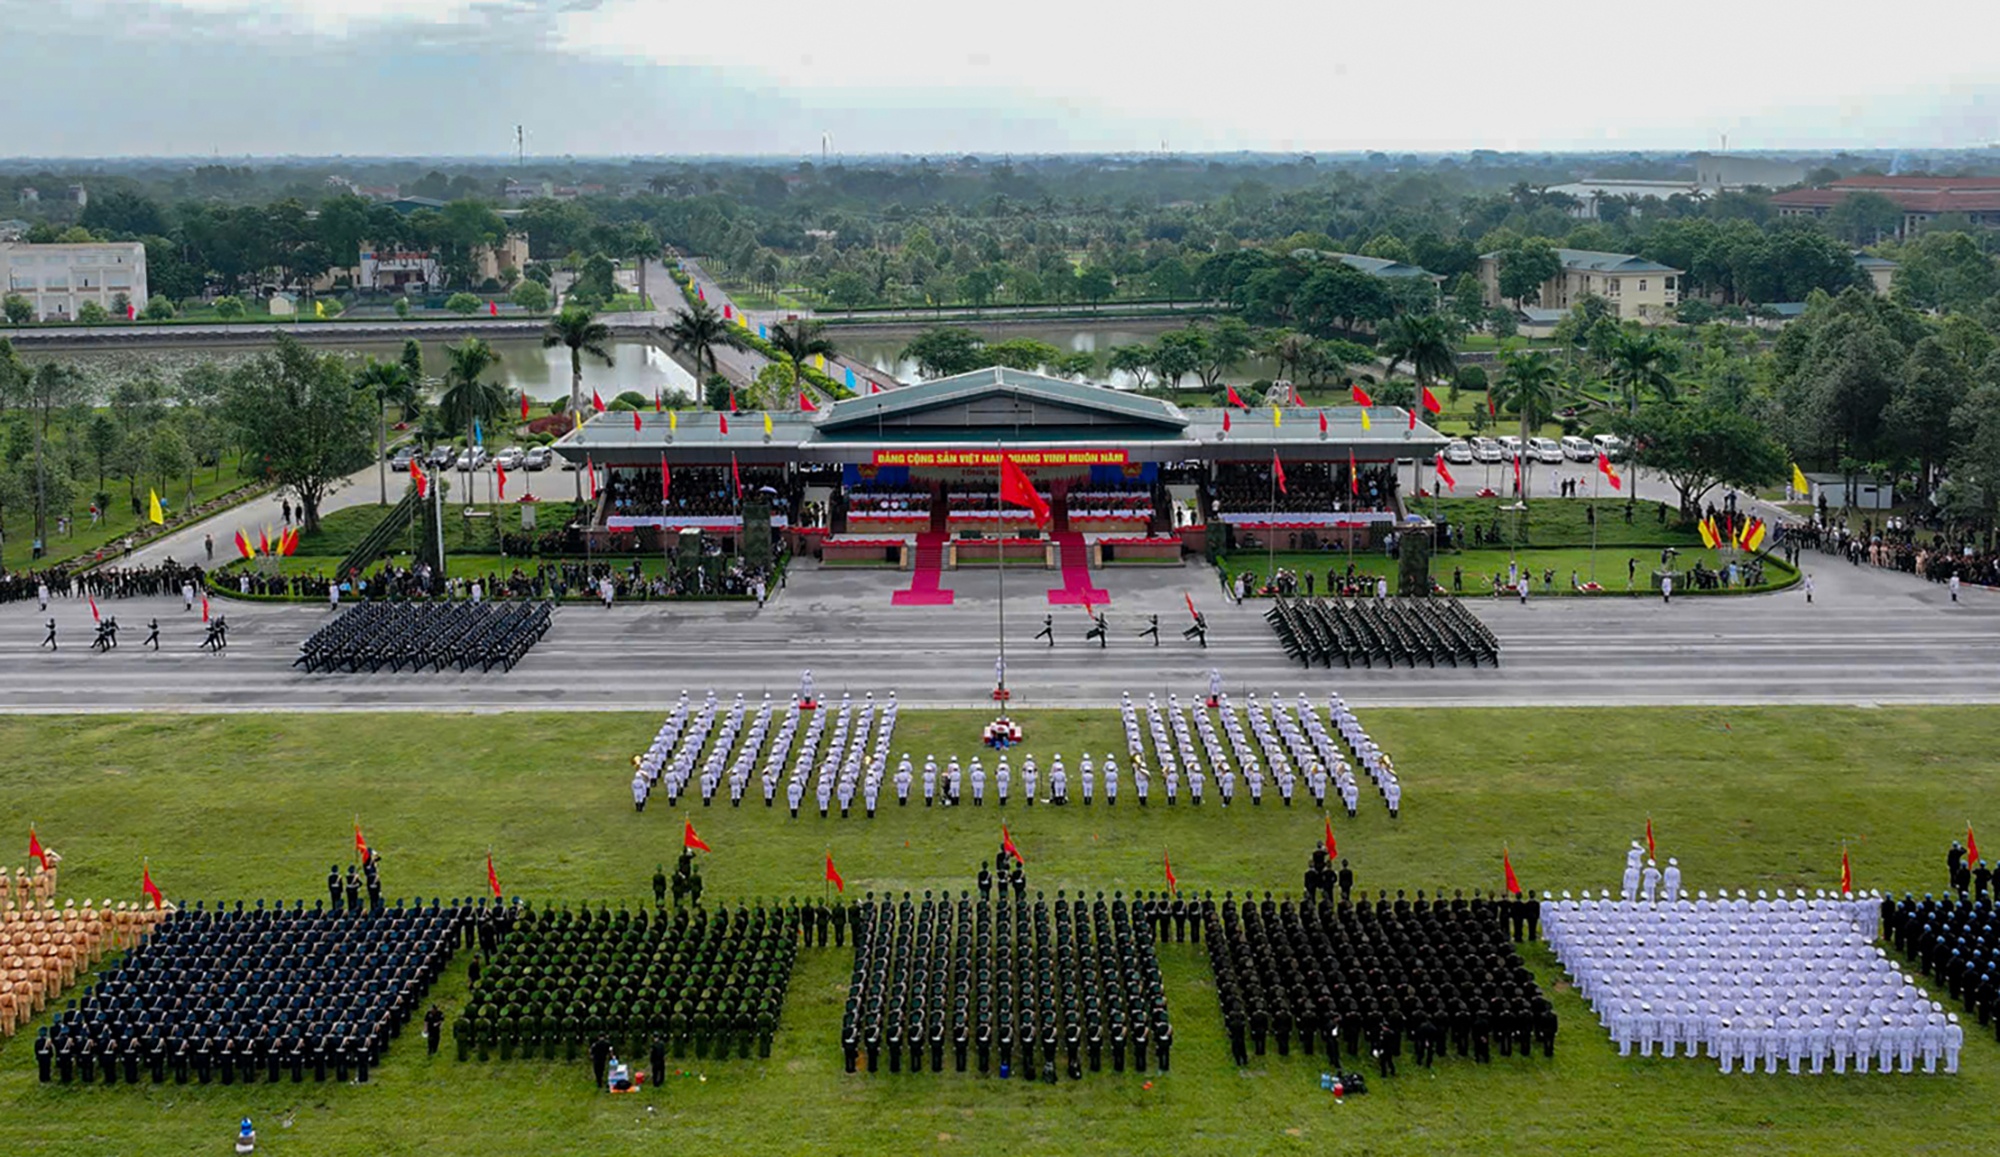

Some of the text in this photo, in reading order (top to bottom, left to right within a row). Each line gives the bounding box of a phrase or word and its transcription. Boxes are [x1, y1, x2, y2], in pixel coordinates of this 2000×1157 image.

[907, 453, 934, 465] CỘNG
[937, 451, 957, 463] SẢN
[959, 453, 980, 465] VIỆT
[1043, 454, 1066, 462] VINH
[1069, 452, 1098, 462] MUÔN
